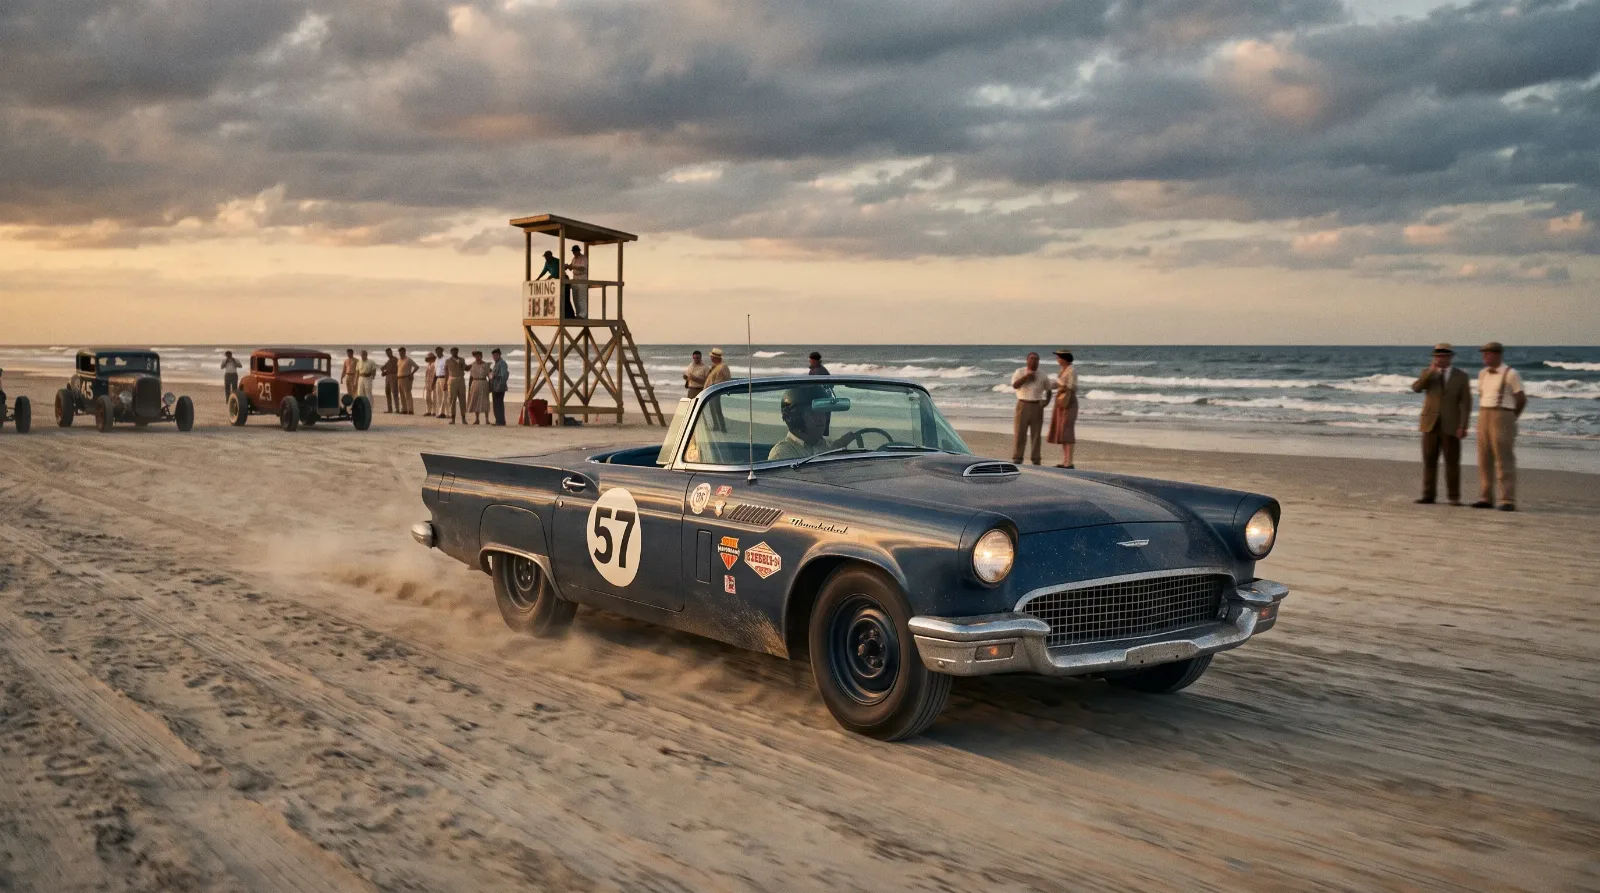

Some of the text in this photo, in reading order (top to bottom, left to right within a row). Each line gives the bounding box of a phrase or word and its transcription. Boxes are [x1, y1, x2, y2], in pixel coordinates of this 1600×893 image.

[528, 281, 556, 296] TIMING
[81, 381, 94, 400] 45
[257, 382, 272, 401] 29
[594, 506, 636, 568] 57
